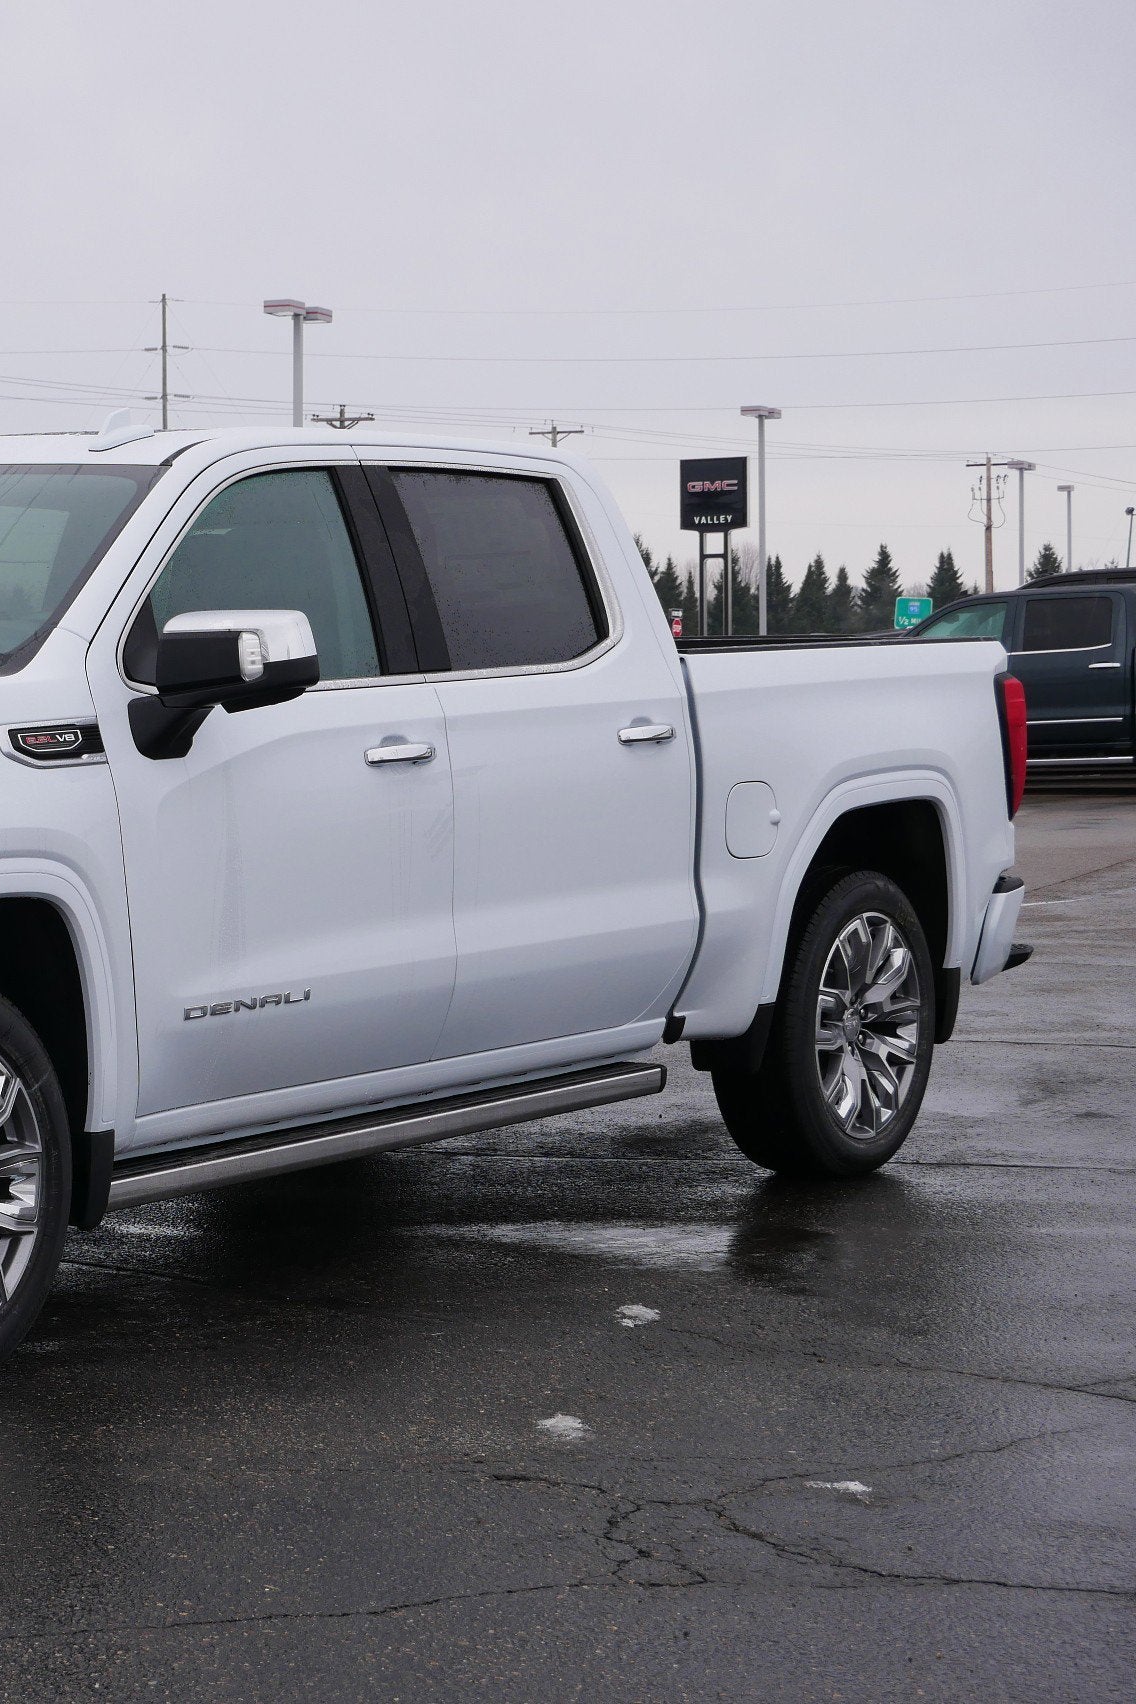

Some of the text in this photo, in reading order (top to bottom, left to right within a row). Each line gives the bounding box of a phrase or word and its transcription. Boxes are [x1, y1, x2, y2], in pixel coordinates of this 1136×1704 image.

[687, 480, 738, 492] GMC
[694, 515, 732, 524] VALLEY
[56, 733, 76, 742] V8
[183, 986, 312, 1021] DENALI
